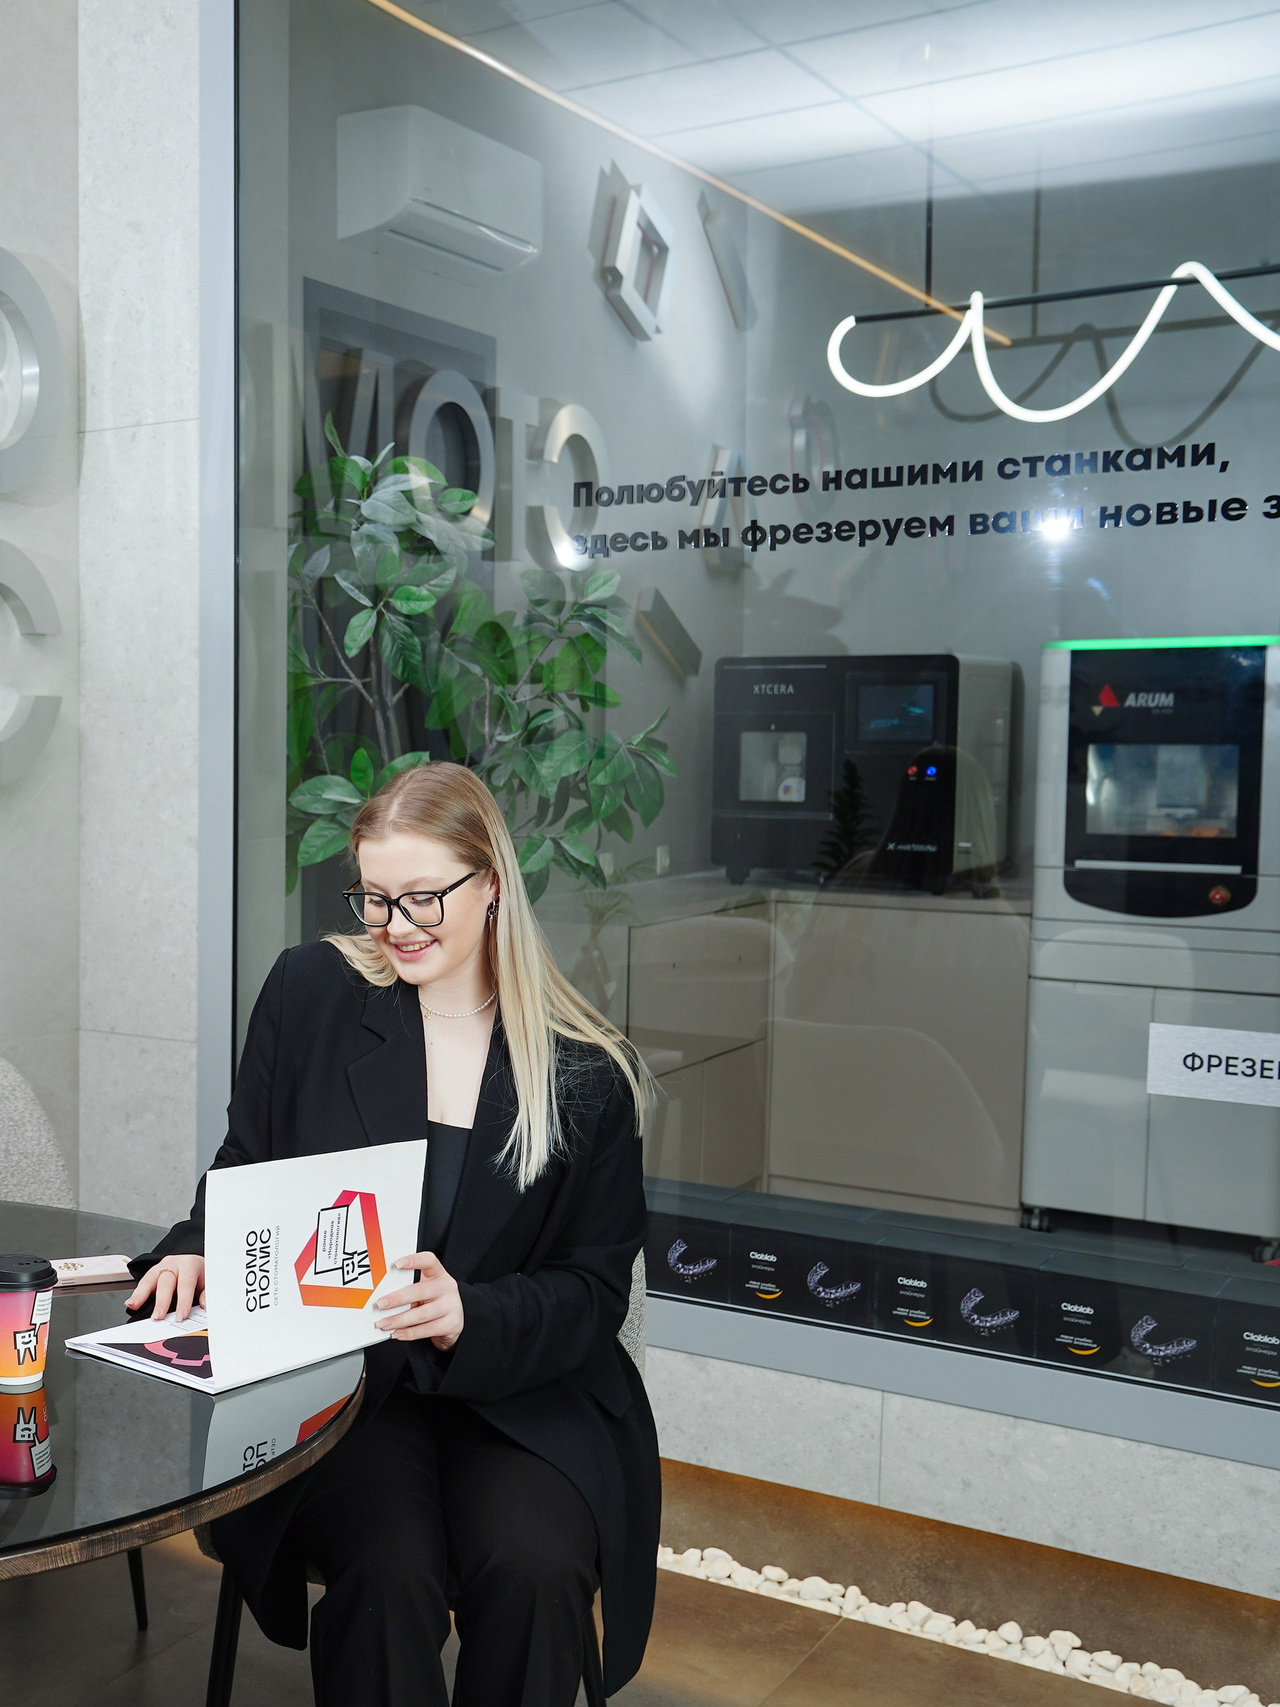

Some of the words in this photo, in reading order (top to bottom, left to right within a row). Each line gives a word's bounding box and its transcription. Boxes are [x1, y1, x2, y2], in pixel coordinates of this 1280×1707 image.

[573, 471, 810, 507] Полюбуйтесь
[821, 459, 984, 492] нашими
[996, 442, 1231, 481] станками,
[572, 530, 668, 559] здесь
[677, 527, 730, 550] мы
[740, 512, 955, 553] фрезеруем
[1099, 497, 1249, 529] новые
[753, 683, 795, 695] XTCERA
[1123, 691, 1175, 708] ARUM
[1182, 1052, 1280, 1080] ФРЕЗЕ
[245, 1230, 258, 1313] СТОМО
[258, 1228, 272, 1310] ПОЛИС
